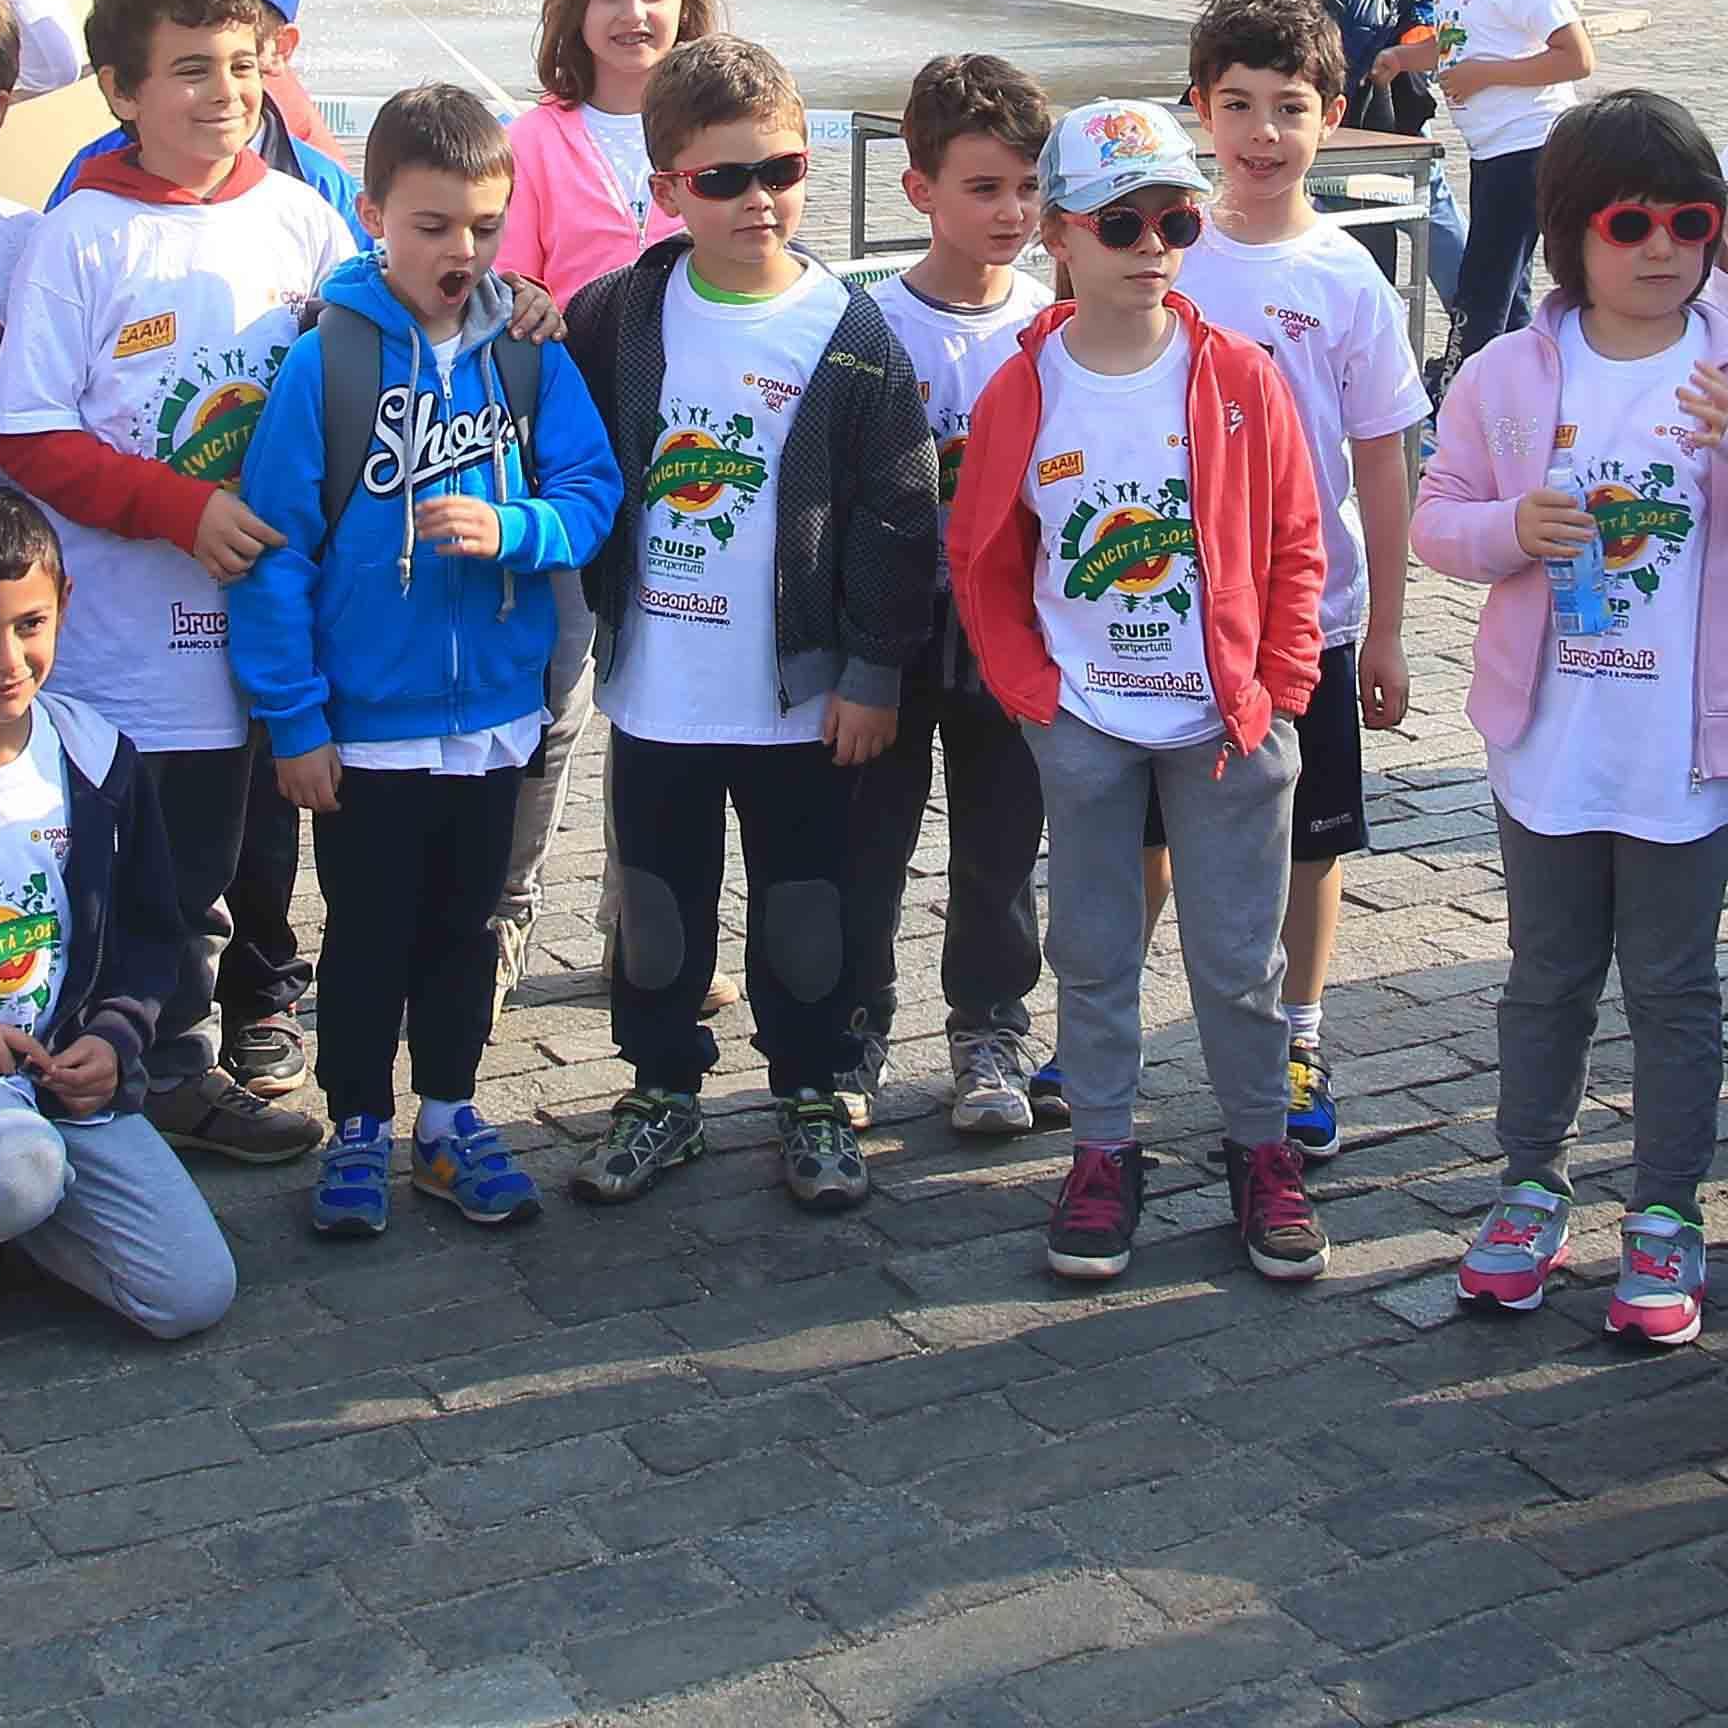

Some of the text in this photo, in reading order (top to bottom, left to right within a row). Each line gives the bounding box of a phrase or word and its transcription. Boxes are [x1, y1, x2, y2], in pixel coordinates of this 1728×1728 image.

[1278, 308, 1321, 328] CONAD
[757, 376, 802, 397] CONAD
[714, 462, 756, 479] 2015
[1039, 453, 1080, 477] CAAM
[664, 539, 706, 560] UISP
[171, 602, 228, 637] bruc
[1126, 622, 1170, 638] UISP
[1086, 663, 1204, 693] brucoconto.it
